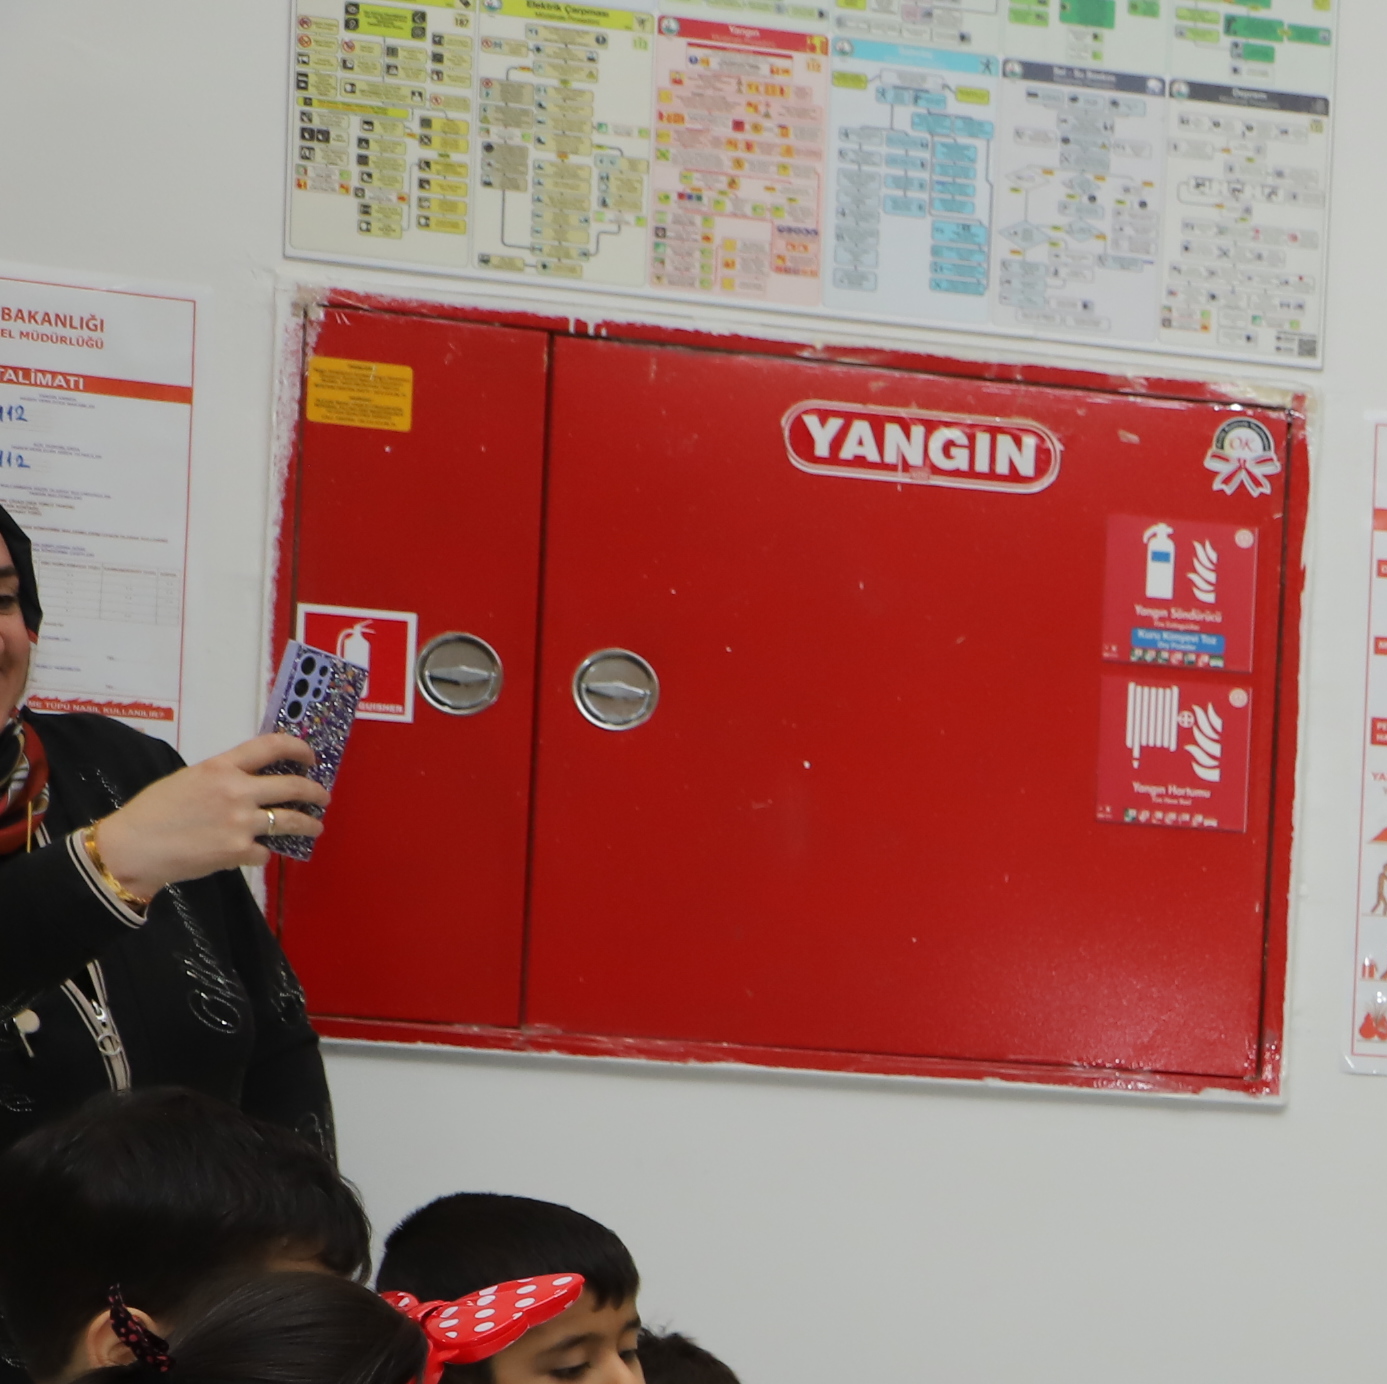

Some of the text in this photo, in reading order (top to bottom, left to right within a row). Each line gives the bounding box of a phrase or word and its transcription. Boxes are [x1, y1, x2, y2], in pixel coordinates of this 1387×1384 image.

[1, 307, 105, 333] BAKANLIĞI
[20, 330, 104, 350] MÜDÜRLÜĞÜ
[801, 413, 1036, 478] YANGIN
